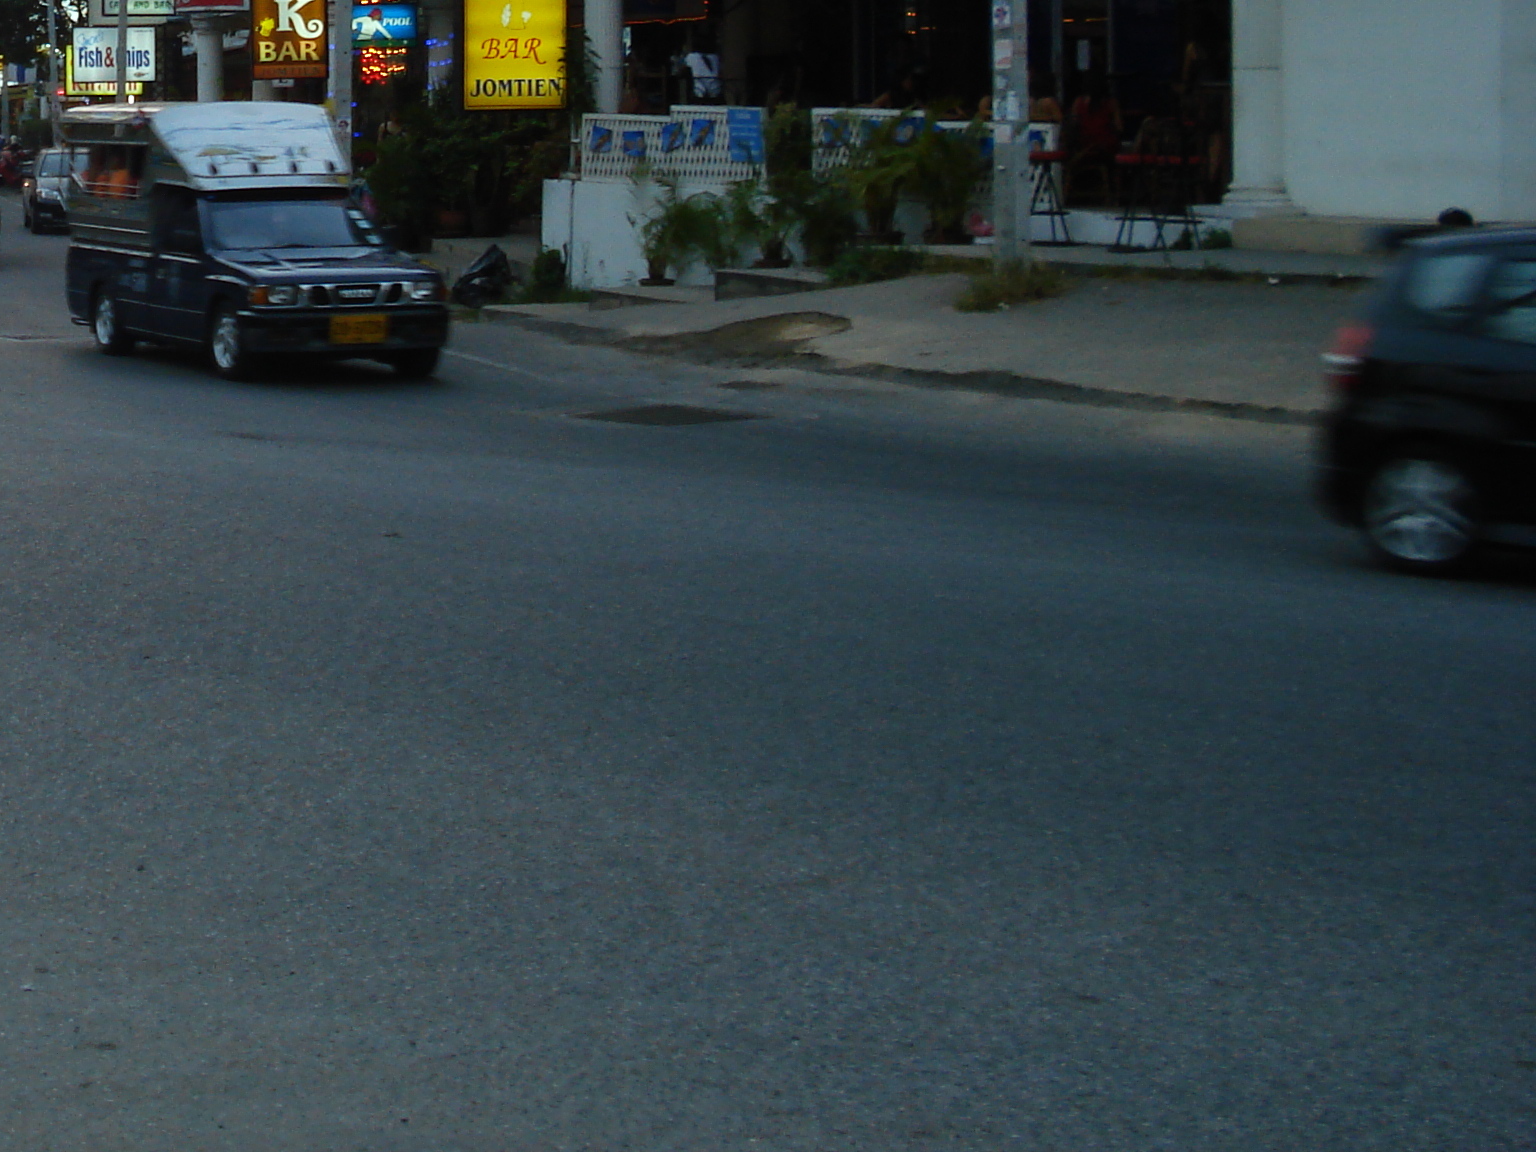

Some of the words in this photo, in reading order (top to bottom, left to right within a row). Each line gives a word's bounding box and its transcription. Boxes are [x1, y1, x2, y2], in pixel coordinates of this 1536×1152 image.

[382, 16, 413, 27] POOL
[79, 47, 103, 68] Fish
[104, 47, 115, 68] &
[258, 41, 321, 63] BAR
[481, 38, 547, 65] BAR
[470, 79, 563, 98] JOMTIEN
